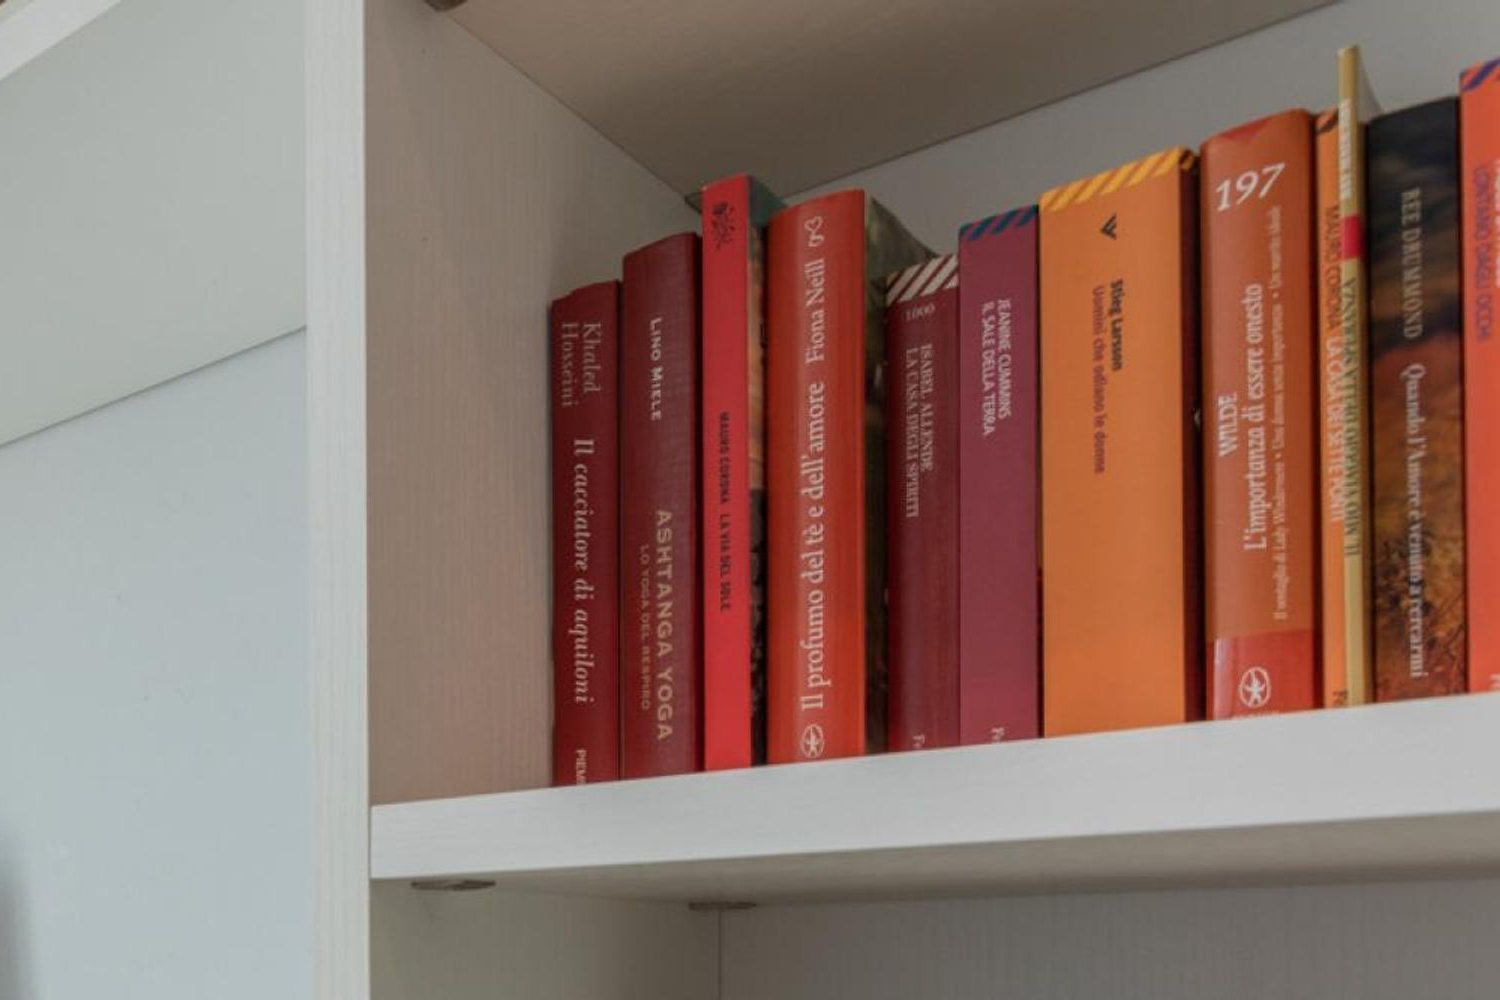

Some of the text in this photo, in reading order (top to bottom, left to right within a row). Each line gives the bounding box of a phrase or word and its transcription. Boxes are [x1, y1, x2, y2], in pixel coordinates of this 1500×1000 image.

[1215, 162, 1286, 213] 197
[804, 258, 825, 365] Fiona Neill
[1401, 188, 1423, 339] REE DRUMMOND
[561, 321, 579, 408] Hosseini
[582, 321, 602, 394] Khaled
[649, 317, 662, 422] LINO MIELE
[981, 301, 998, 436] IL SALE DELLA TERRA
[998, 299, 1013, 420] JEANINE CUMMINS
[1108, 278, 1125, 372] Stieg Larsson
[920, 343, 934, 472] ISABEL ALLENDE
[1092, 284, 1109, 474] Uomini che odiano le donne
[1218, 394, 1240, 457] WILDE
[1240, 282, 1272, 551] L'importanza di essere onesto
[1399, 362, 1426, 435] Quando
[719, 411, 732, 505] MAURO CORONA
[905, 347, 920, 518] LA CASA DEGLI SPIRITI
[1406, 436, 1428, 507] l'Amore
[568, 437, 596, 704] Il cacciatore di aquiloni
[719, 513, 731, 530] LA
[719, 531, 732, 551] VIA
[719, 554, 732, 578] DEL
[800, 382, 831, 711] Il profumo del tè e dell'amore
[639, 543, 652, 711] LO YOGA DEL RESPIRO
[655, 509, 674, 741] ASHTANGA YOGA
[1408, 598, 1429, 678] cercarmi
